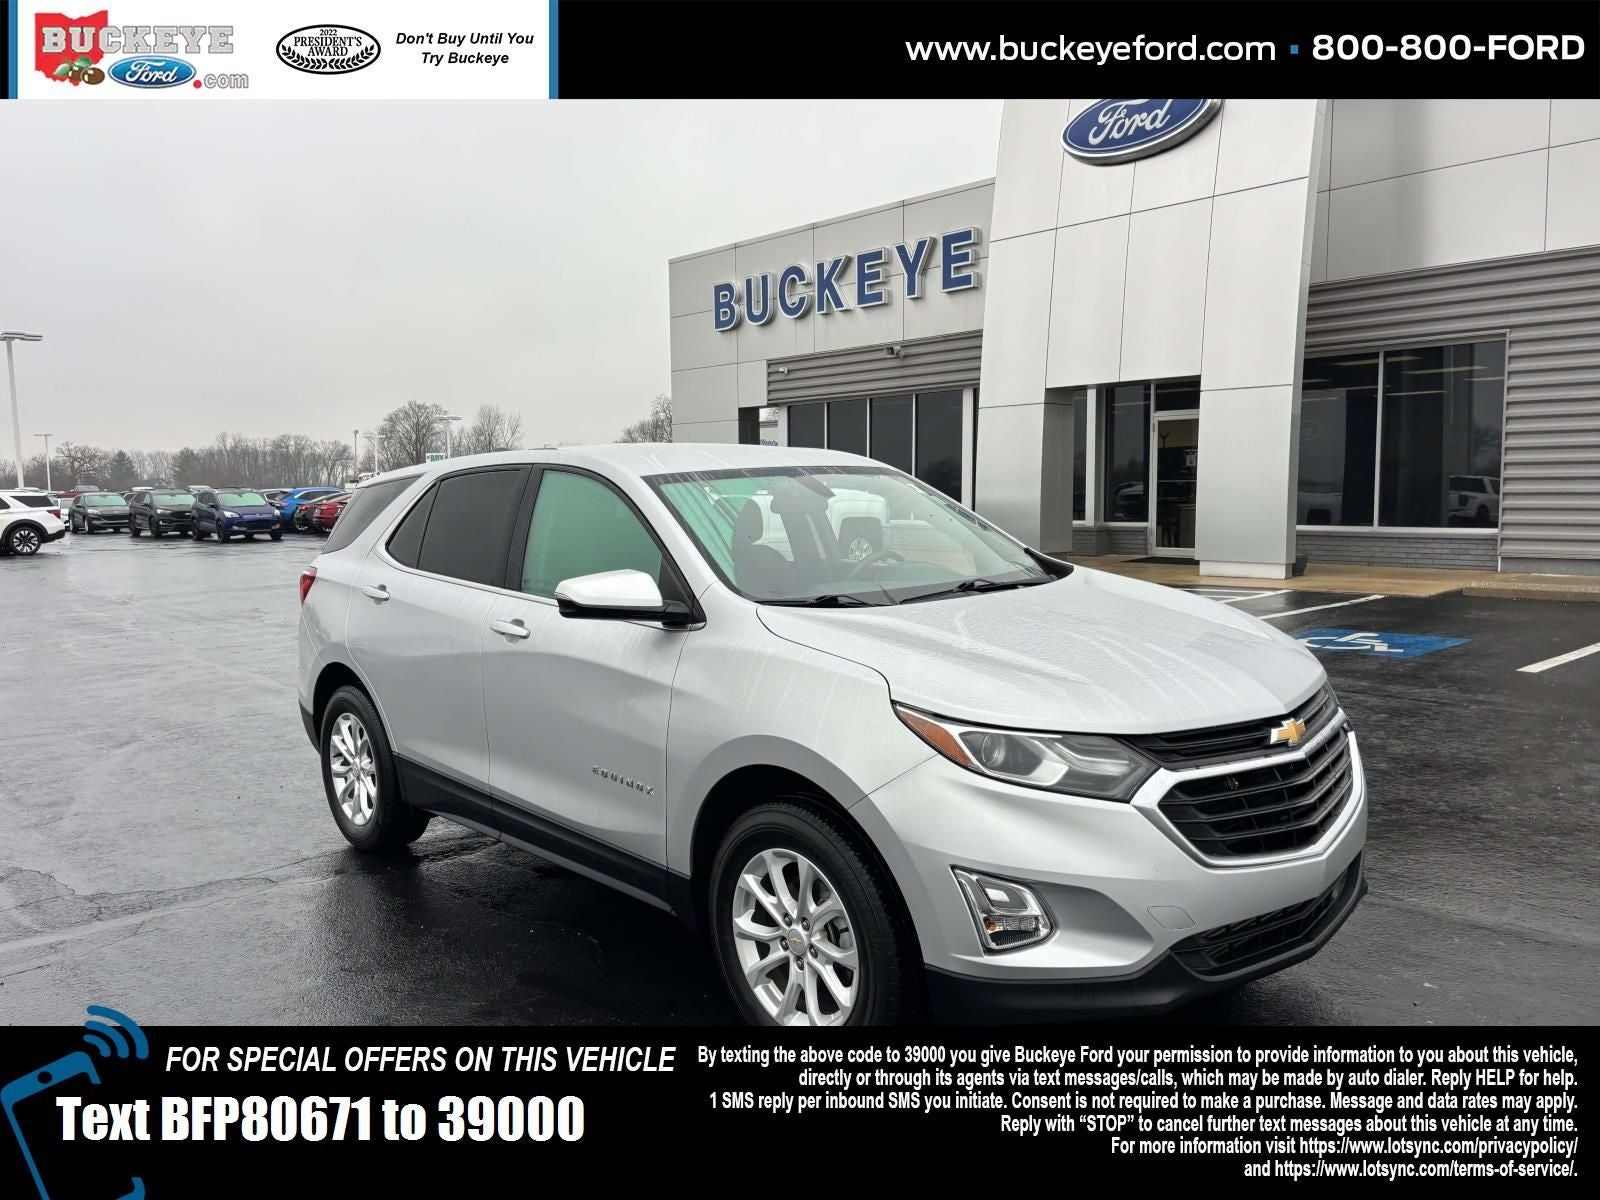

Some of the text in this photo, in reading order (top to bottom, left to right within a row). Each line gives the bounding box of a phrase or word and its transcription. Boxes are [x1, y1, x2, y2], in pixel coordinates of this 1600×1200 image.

[1087, 98, 1172, 146] Ford
[712, 226, 982, 333] BUCKEYE
[591, 764, 656, 797] EQUINOX
